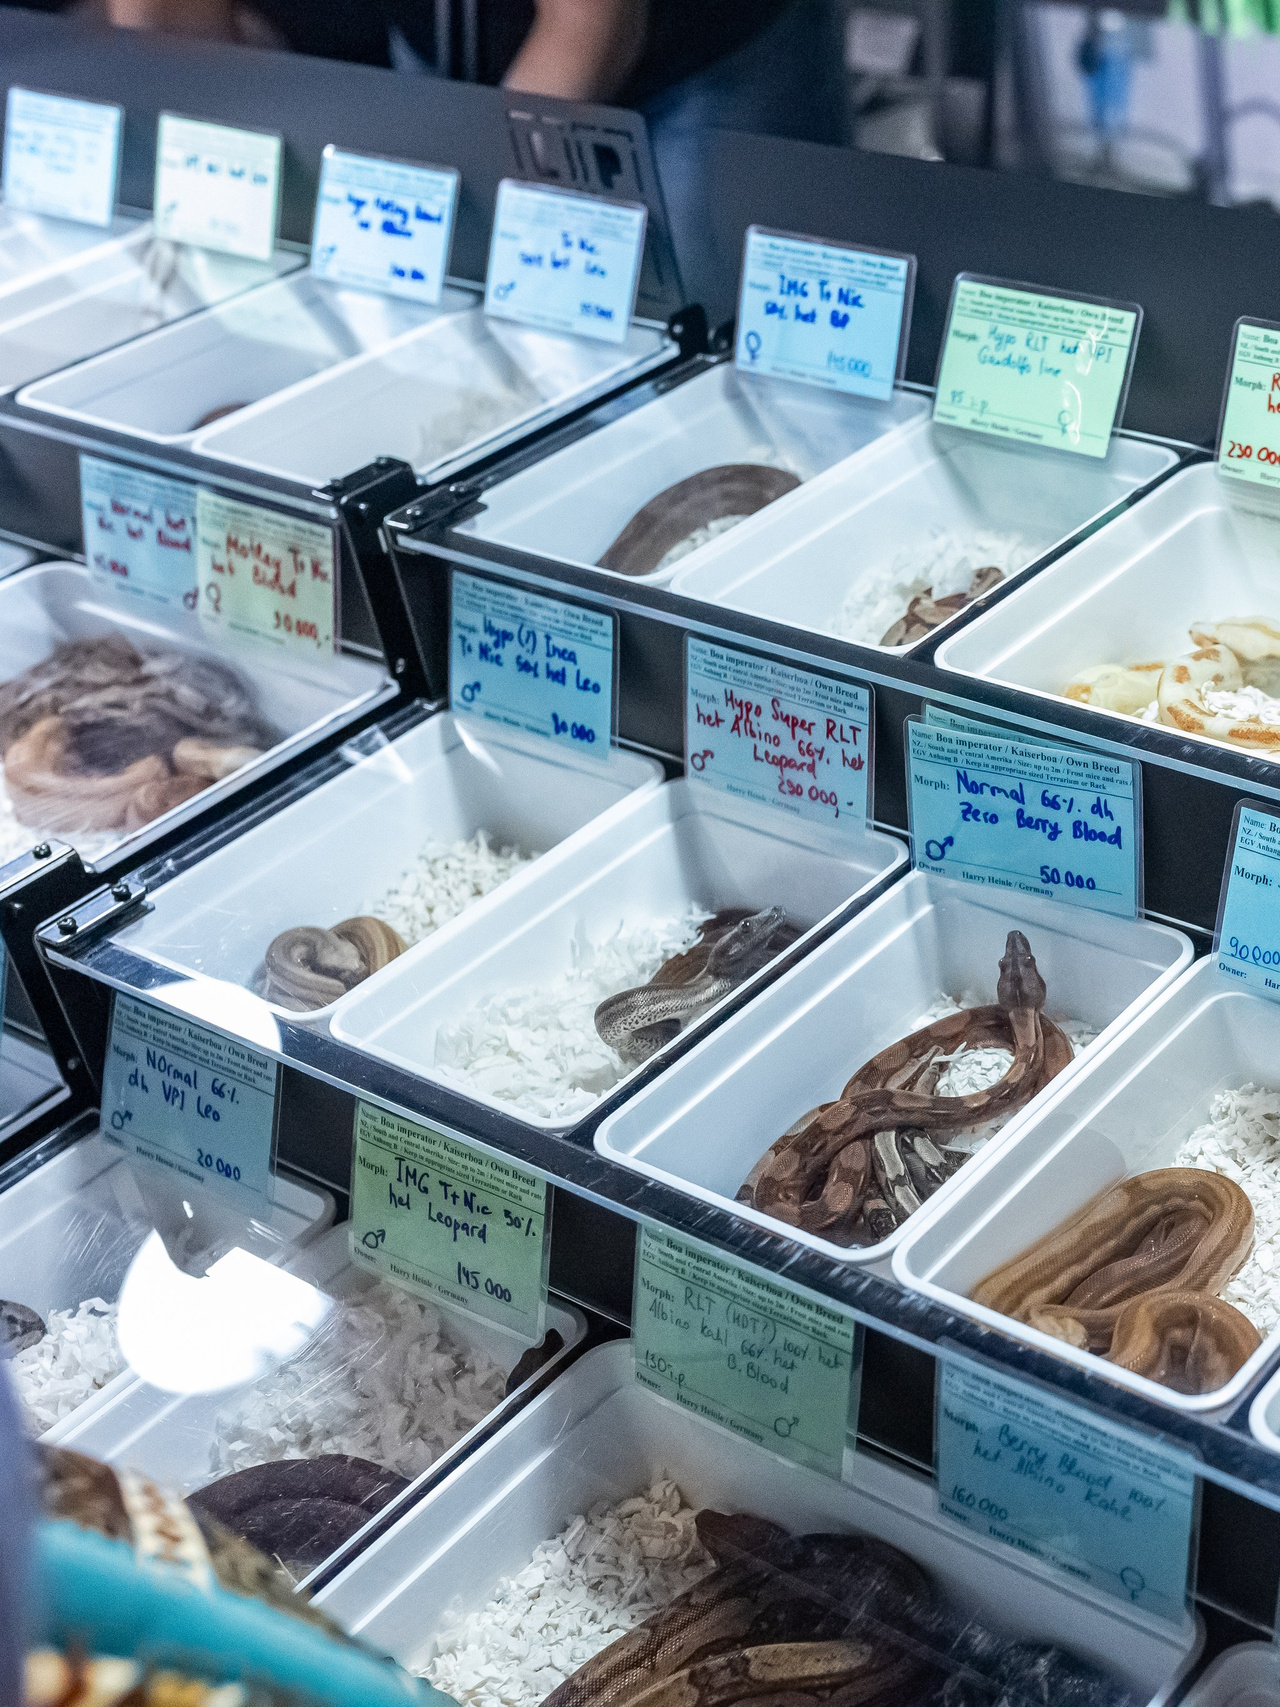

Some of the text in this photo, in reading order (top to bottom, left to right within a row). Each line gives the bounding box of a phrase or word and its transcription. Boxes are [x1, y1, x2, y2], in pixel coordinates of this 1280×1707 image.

[695, 703, 726, 729] het
[730, 714, 781, 748] Albino
[724, 688, 862, 745] Hypo Super RLT
[753, 743, 817, 780] Leopard
[956, 769, 1026, 806] Normal
[1091, 796, 1114, 821] dh
[959, 801, 1123, 850] Zero Berry Blood
[1243, 814, 1267, 829] Name:
[128, 1068, 149, 1094] dh
[196, 1095, 221, 1123] Leo
[394, 1157, 430, 1195] IMG
[428, 1201, 488, 1245] Leopard
[684, 1286, 716, 1316] RLT
[648, 1298, 691, 1331] Albino
[773, 1349, 799, 1372] het
[746, 1361, 790, 1395] Blood
